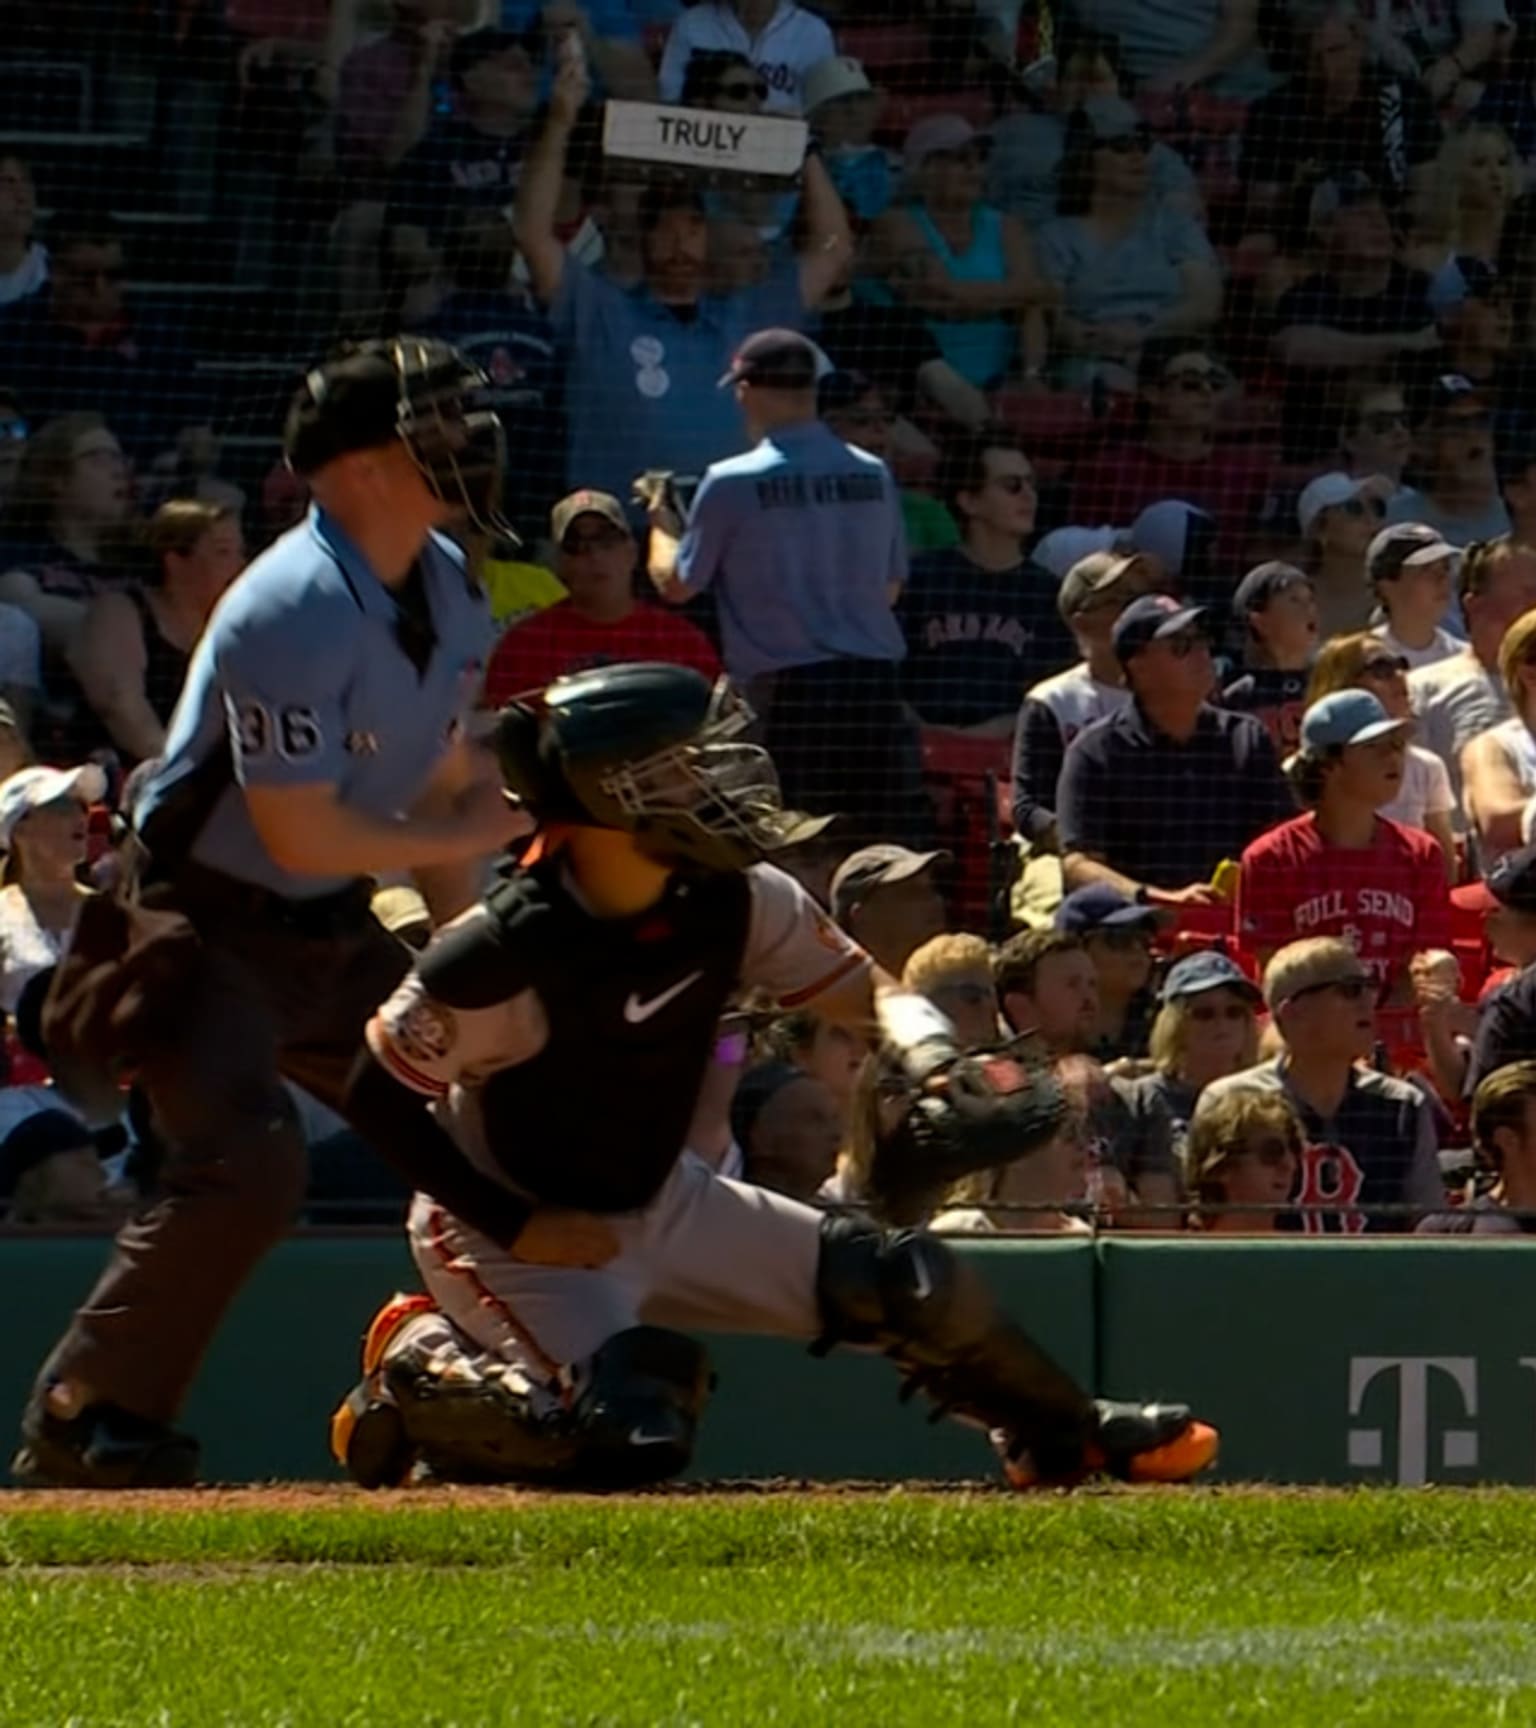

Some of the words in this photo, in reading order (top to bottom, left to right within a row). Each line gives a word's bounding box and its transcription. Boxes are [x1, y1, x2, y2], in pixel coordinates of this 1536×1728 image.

[657, 115, 747, 151] TRULY
[757, 478, 807, 510] BEER
[1293, 890, 1348, 933] FULL
[1358, 888, 1414, 929] SEND
[1347, 1354, 1478, 1487] T
